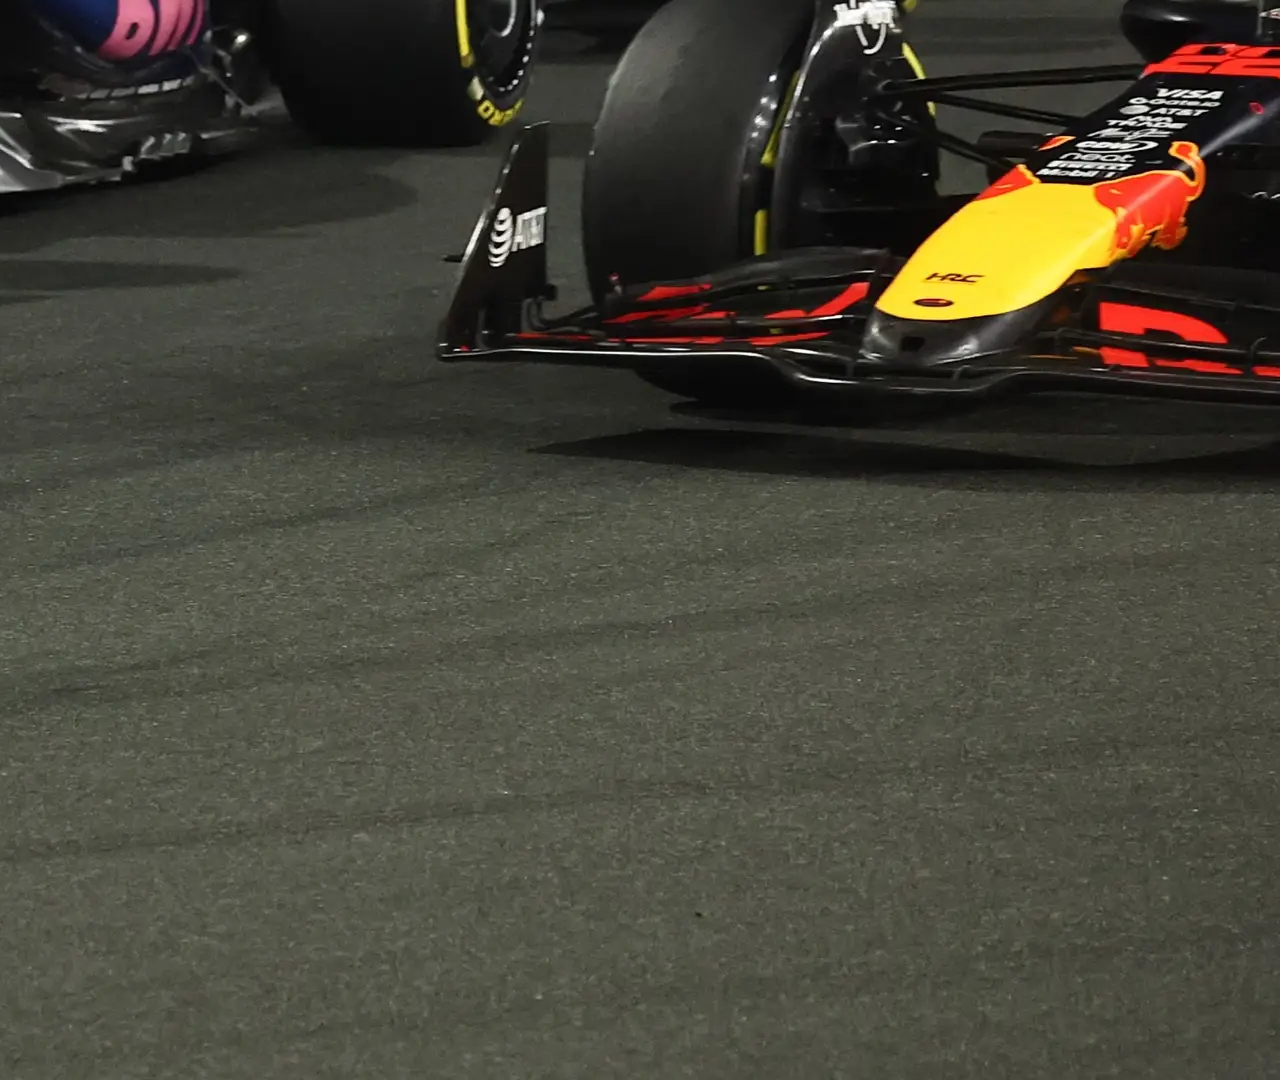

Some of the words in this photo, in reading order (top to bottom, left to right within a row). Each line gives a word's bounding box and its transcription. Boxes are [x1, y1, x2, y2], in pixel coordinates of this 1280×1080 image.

[1156, 87, 1225, 101] VISA
[1149, 106, 1210, 117] AT&T
[1105, 119, 1188, 130] TRADE
[1035, 167, 1099, 178] Mobil
[924, 272, 984, 284] HRC
